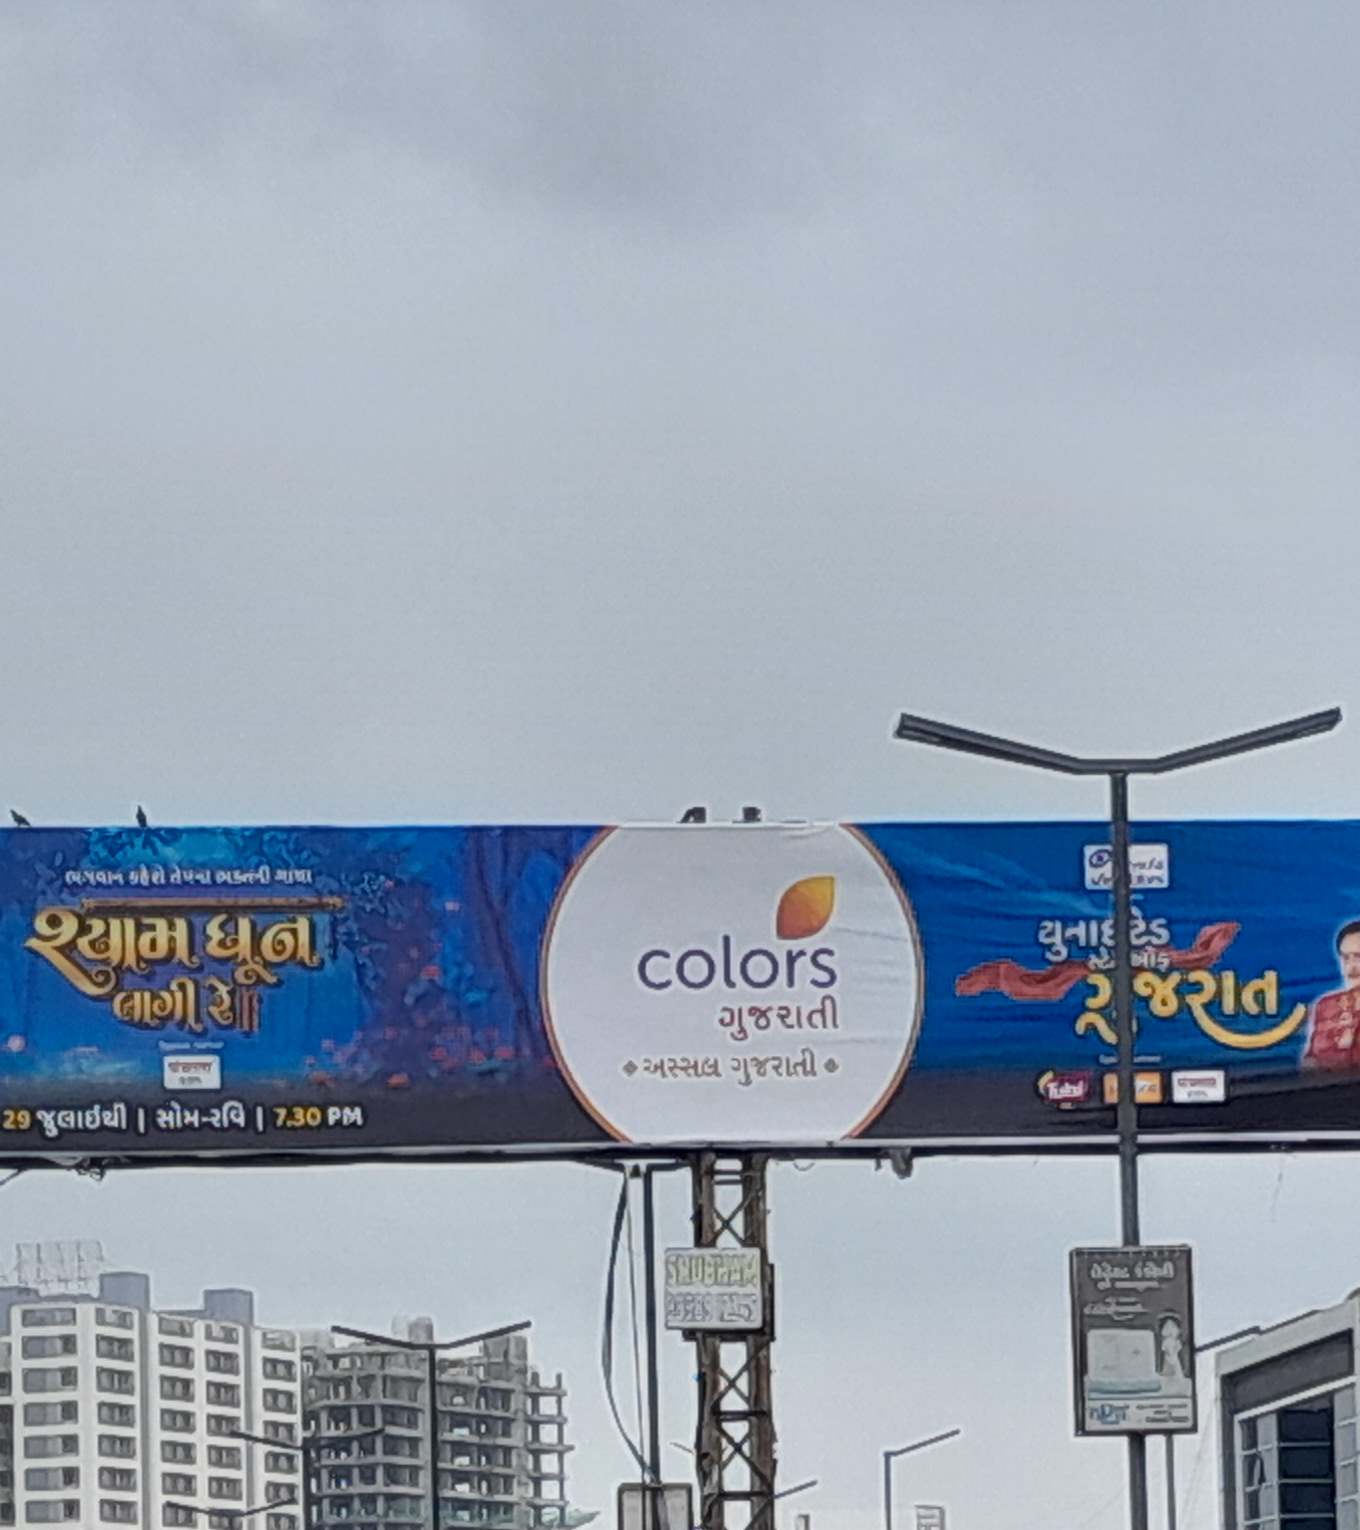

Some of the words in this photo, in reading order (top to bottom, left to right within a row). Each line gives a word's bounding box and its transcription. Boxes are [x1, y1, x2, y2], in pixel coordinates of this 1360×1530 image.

[24, 907, 202, 996] શ્યામ
[205, 912, 322, 986] ધૂન
[638, 934, 838, 991] colors
[113, 974, 204, 1033] લાગી
[718, 994, 839, 1042] ગુજરાતી
[643, 1056, 722, 1080] અસ્સલ
[731, 1047, 817, 1087] ગુજરાતી
[2, 1109, 31, 1130] 29
[274, 1107, 322, 1128] 7.30
[327, 1106, 364, 1127] PM
